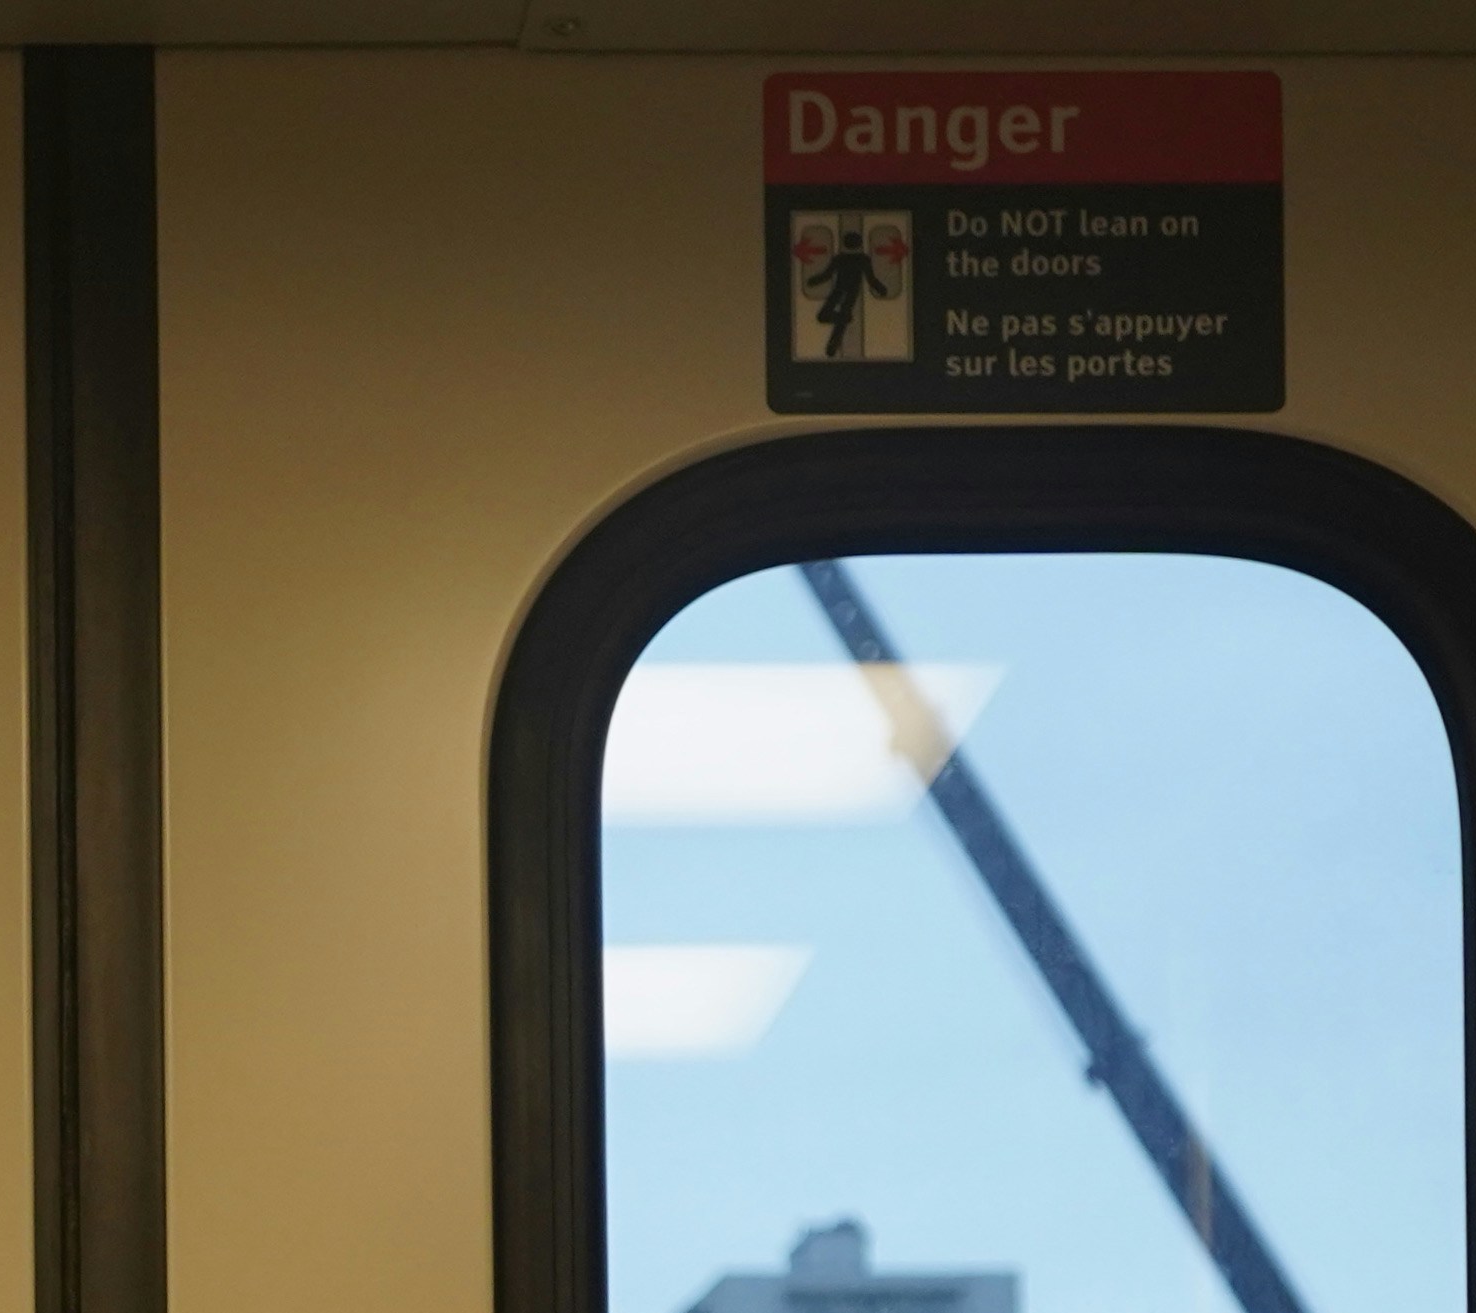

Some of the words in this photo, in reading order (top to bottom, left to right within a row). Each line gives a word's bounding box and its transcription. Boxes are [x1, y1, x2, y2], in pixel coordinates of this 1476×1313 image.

[788, 90, 1081, 171] Danger
[948, 210, 989, 237] Do
[1000, 210, 1068, 237] NOT
[1080, 209, 1148, 236] lean
[1160, 213, 1200, 236] on
[947, 251, 999, 277] the
[1010, 249, 1102, 277] doors
[947, 310, 989, 336] Ne
[1001, 312, 1057, 341] pas
[1068, 308, 1228, 341] s'appuyer
[946, 354, 997, 377] sur
[1009, 348, 1056, 377] les
[1067, 348, 1173, 381] portes
